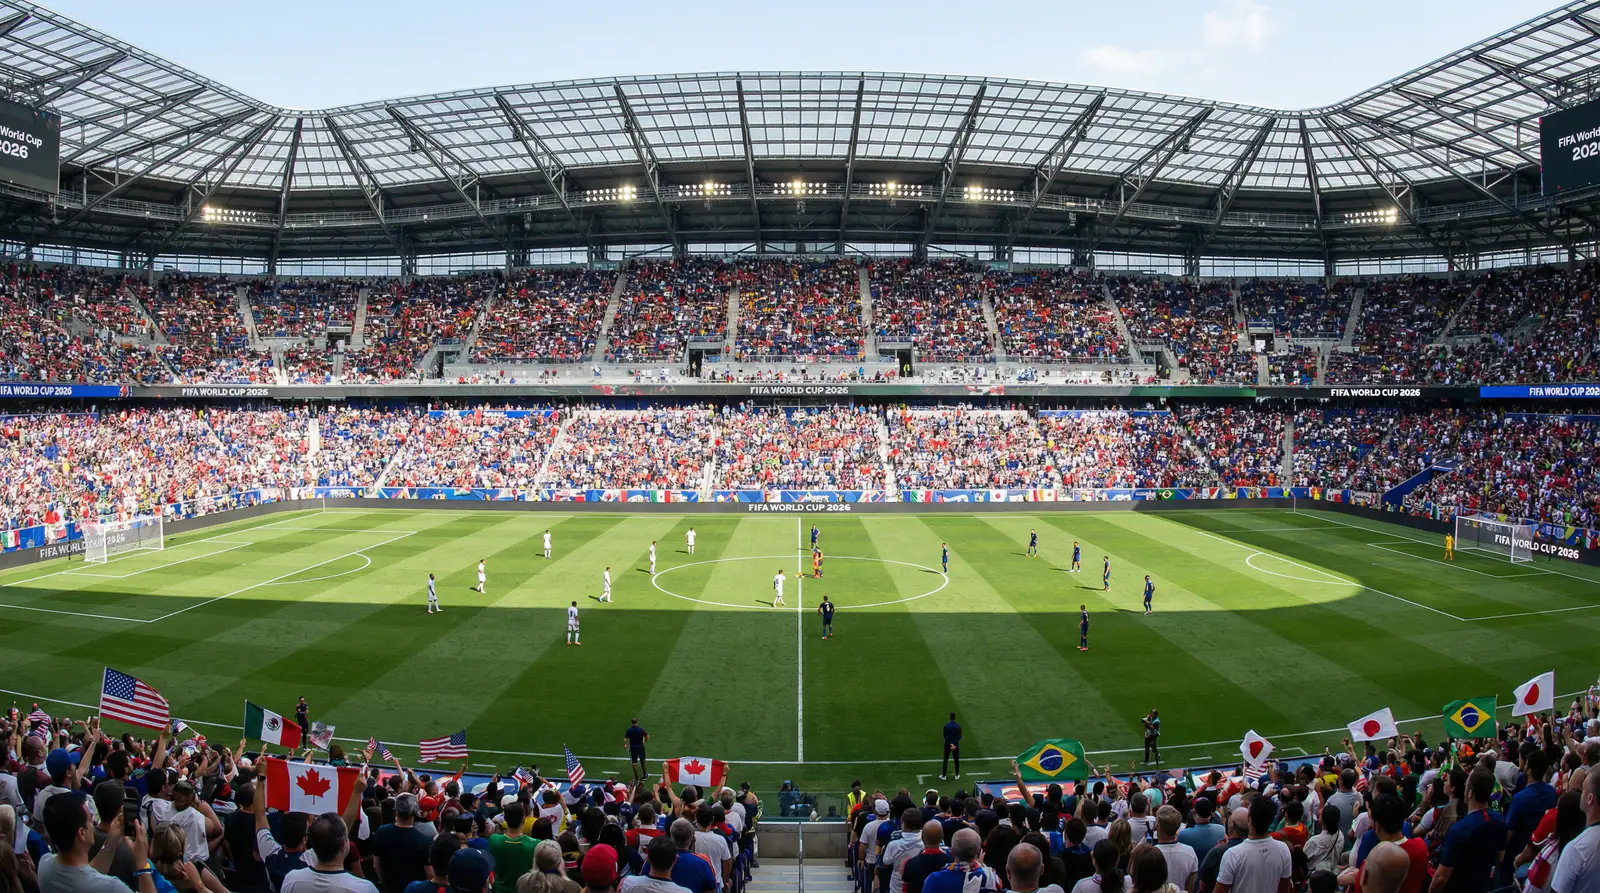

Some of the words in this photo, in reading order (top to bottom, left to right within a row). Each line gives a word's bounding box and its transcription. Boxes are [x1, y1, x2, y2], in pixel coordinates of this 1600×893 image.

[0, 125, 25, 141] World
[25, 133, 43, 148] Cup
[1558, 135, 1576, 148] FIFA
[1576, 126, 1600, 142] World
[0, 140, 29, 159] 026
[1572, 141, 1600, 161] 202
[0, 385, 12, 396] IFA
[13, 385, 39, 396] WORLD
[40, 386, 54, 396] CUP
[54, 386, 72, 396] 2026
[199, 387, 228, 396] WORLD
[228, 388, 246, 396] CUP
[246, 388, 269, 396] 2026
[750, 386, 770, 395] FIFA
[770, 386, 804, 395] WORLD
[805, 386, 824, 395] CUP
[825, 386, 849, 395] 2026
[1330, 388, 1350, 397] FIFA
[1350, 388, 1381, 397] WORLD
[1381, 388, 1399, 397] CUP
[1399, 388, 1421, 397] 2026
[1529, 387, 1544, 396] FIFA
[1544, 386, 1569, 396] WORLD
[1570, 386, 1585, 396] CUP
[1585, 386, 1600, 396] 202
[748, 503, 769, 511] FIFA
[769, 503, 804, 511] WORLD
[805, 503, 825, 511] CUP
[826, 503, 851, 511] 2026
[39, 547, 58, 559] FIFA
[58, 540, 87, 555] WORLD
[1494, 534, 1511, 546] FIFA
[1540, 543, 1557, 554] CUP
[1557, 546, 1579, 560] 2026
